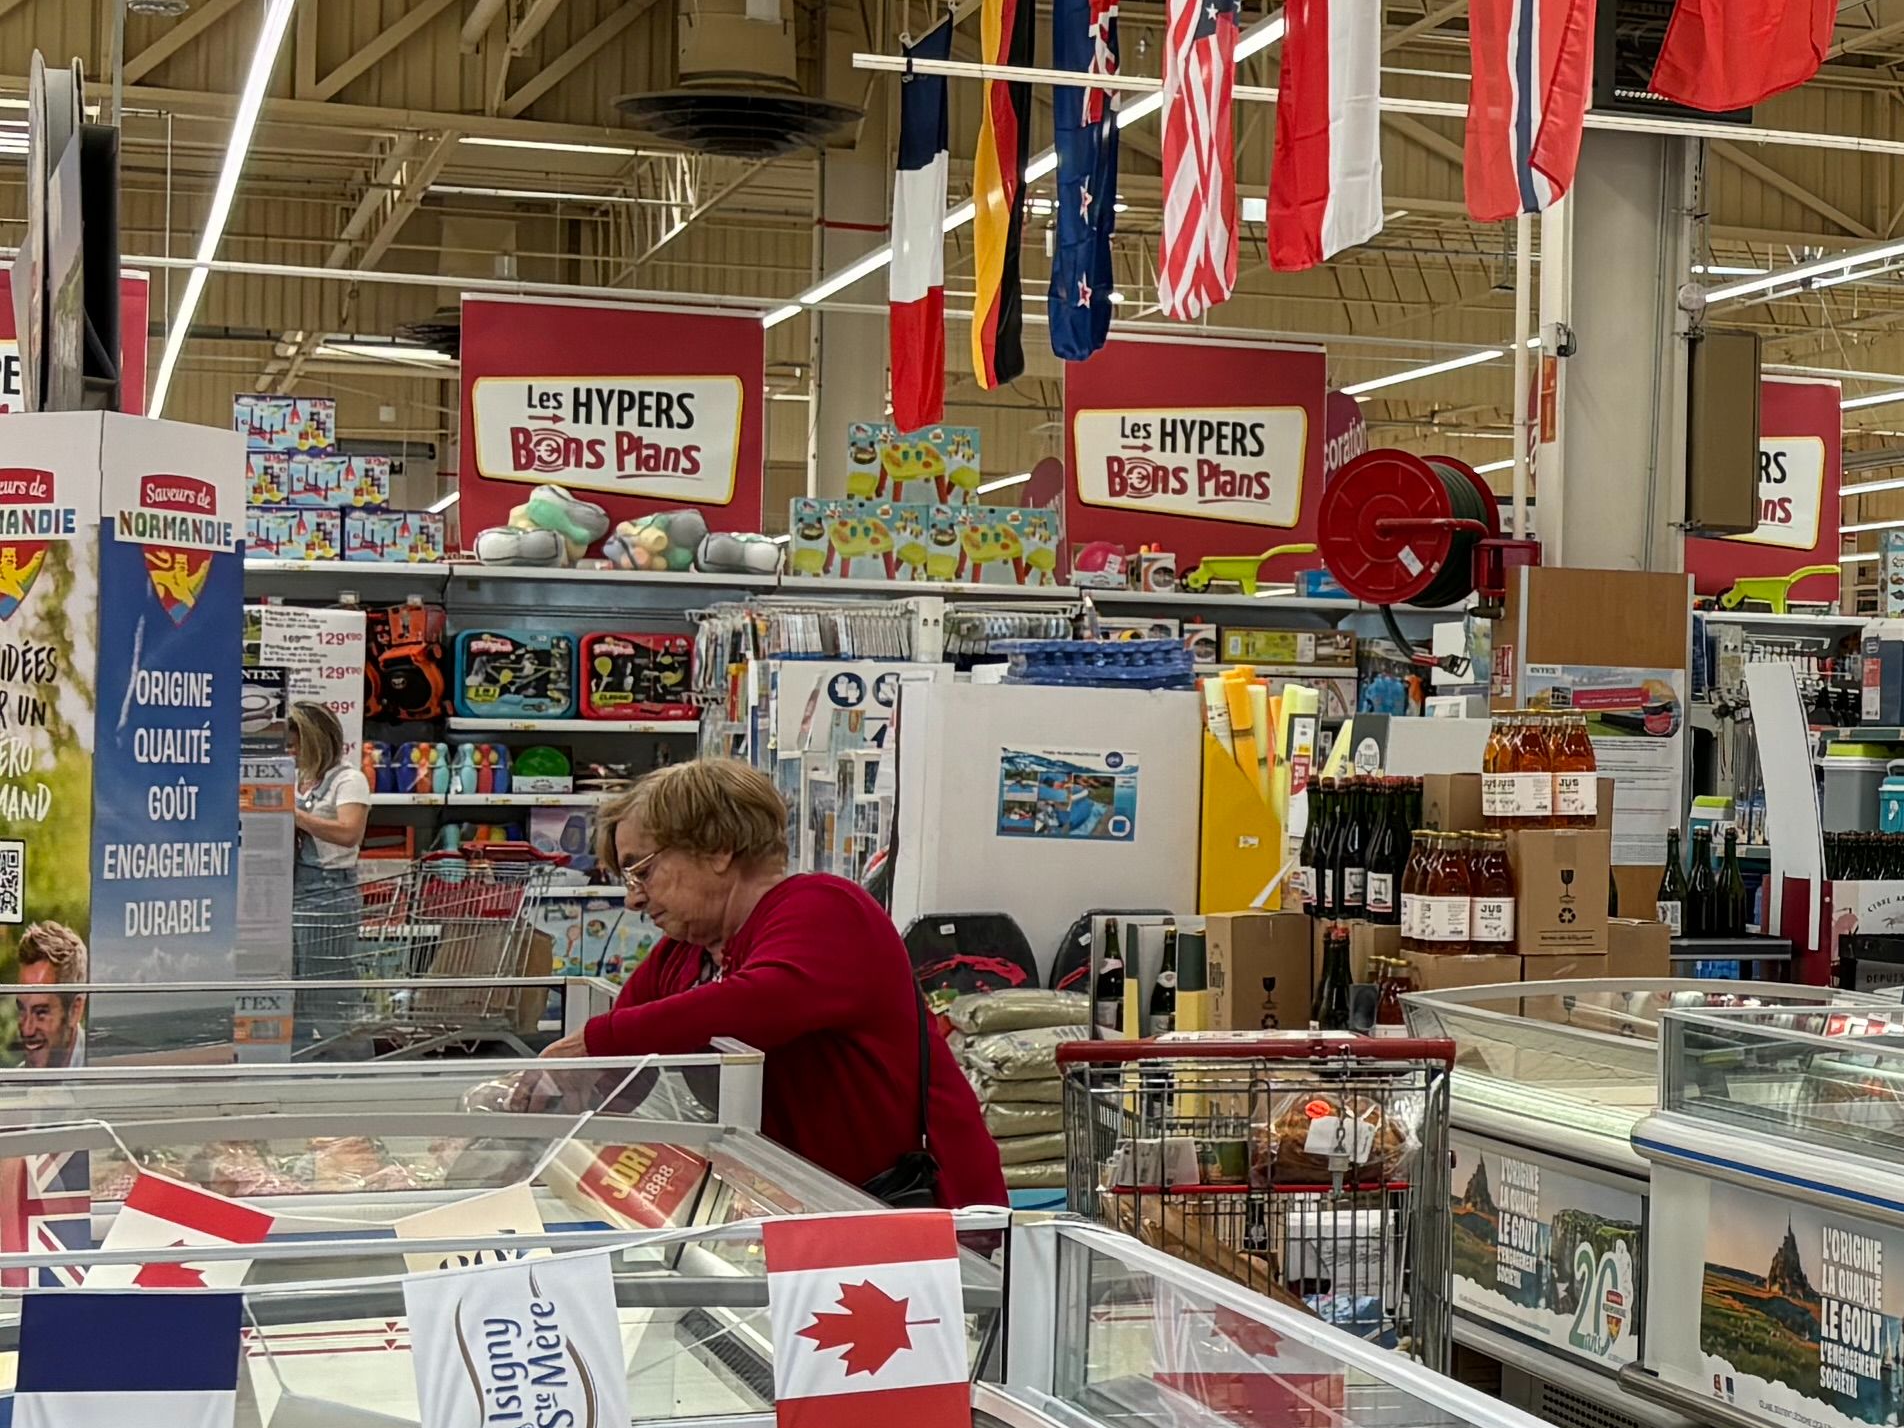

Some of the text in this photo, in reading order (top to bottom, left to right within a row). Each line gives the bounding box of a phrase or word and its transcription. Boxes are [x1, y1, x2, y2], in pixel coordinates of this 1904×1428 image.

[527, 384, 696, 430] Les HYPERS
[615, 431, 702, 475] Plans
[1121, 416, 1266, 458] Les HYPERS
[29, 475, 48, 497] de
[147, 483, 213, 510] Saveurs de
[1196, 458, 1272, 501] Plans
[119, 510, 232, 547] NORMANDIE
[135, 669, 213, 709] ORIGINE
[18, 696, 47, 728] UN
[133, 724, 212, 766] QUALITÉ
[147, 775, 199, 822] GOÛT
[1558, 777, 1580, 789] JUS
[103, 839, 233, 881] ENGAGEMENT
[124, 898, 213, 938] DURABLE
[1480, 903, 1503, 914] JUS
[638, 1164, 674, 1206] 1888
[1821, 1225, 1884, 1273] L'ORIGINE
[1821, 1262, 1884, 1311] LA QUALITÉ
[526, 1300, 569, 1389] Mère
[1820, 1296, 1883, 1355] LE GOÛT
[483, 1318, 529, 1423] Isigny
